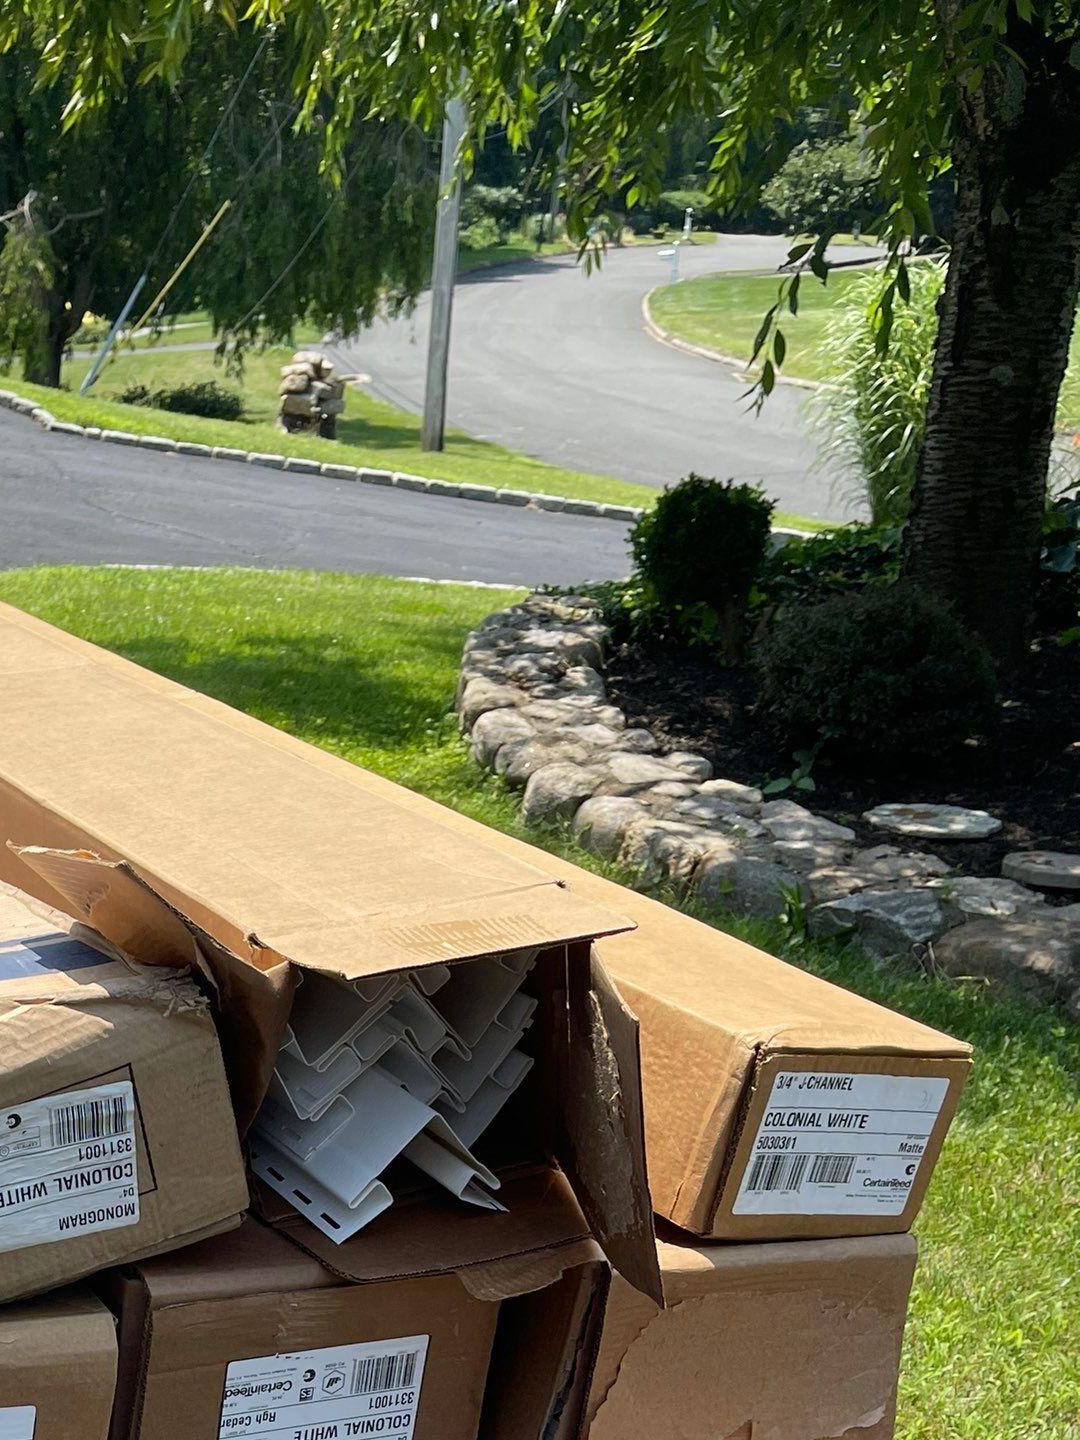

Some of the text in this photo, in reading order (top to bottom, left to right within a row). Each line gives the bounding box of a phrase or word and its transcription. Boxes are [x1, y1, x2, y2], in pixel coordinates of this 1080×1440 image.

[777, 1076, 854, 1091] 3/4" J-CHANNEL
[765, 1113, 869, 1128] COLONIAL WHITE
[79, 1138, 132, 1161] 3311001
[898, 1143, 924, 1153] Matte
[54, 1163, 133, 1192] COLONIAL
[863, 1178, 911, 1188] CertainTeed
[59, 1203, 135, 1230] MONOGRAM
[225, 1381, 293, 1400] CertainTeed
[369, 1391, 414, 1409] 3311001
[220, 1412, 276, 1427] Rgh Cedar
[344, 1414, 410, 1435] COLONIAL
